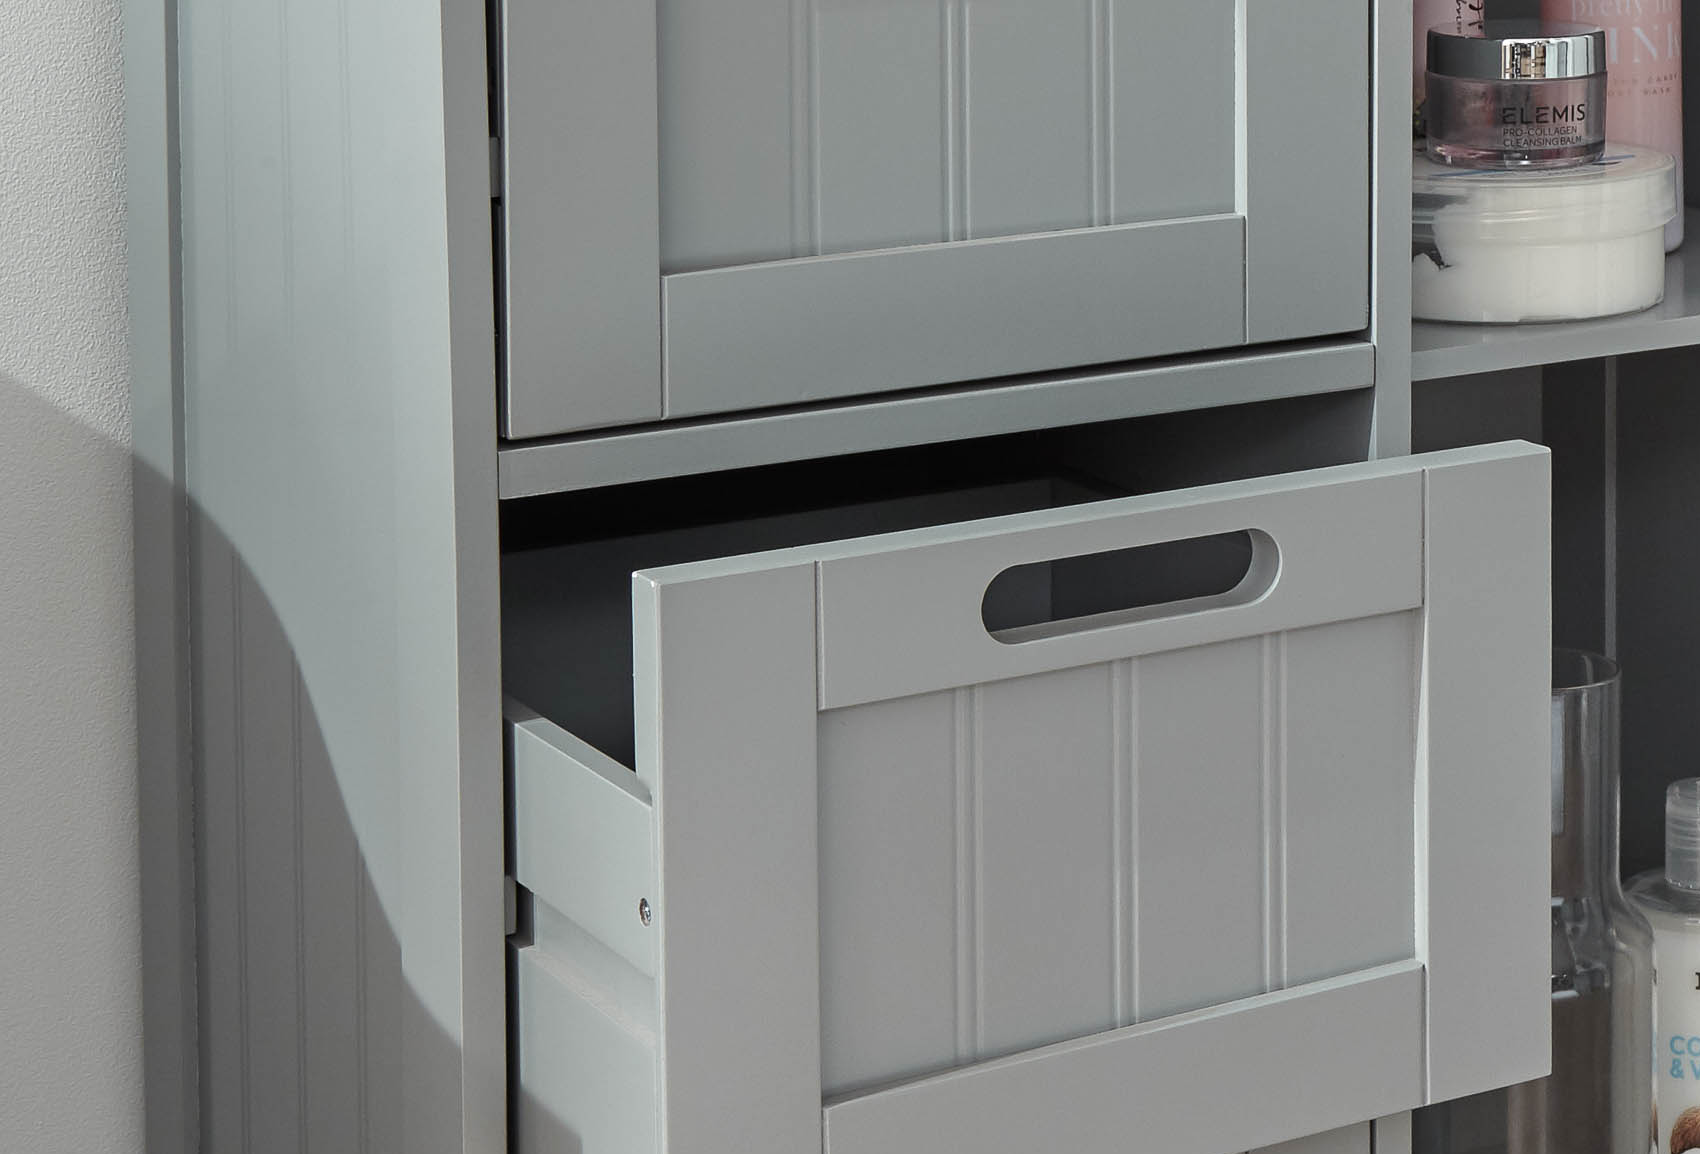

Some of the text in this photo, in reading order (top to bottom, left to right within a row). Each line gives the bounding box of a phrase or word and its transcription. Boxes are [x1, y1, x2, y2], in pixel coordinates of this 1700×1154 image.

[1502, 103, 1586, 125] ELEMIS
[1503, 126, 1577, 137] PRO-COLLAGEN
[1503, 135, 1582, 148] CLEANSING BALM
[1669, 1058, 1685, 1080] &
